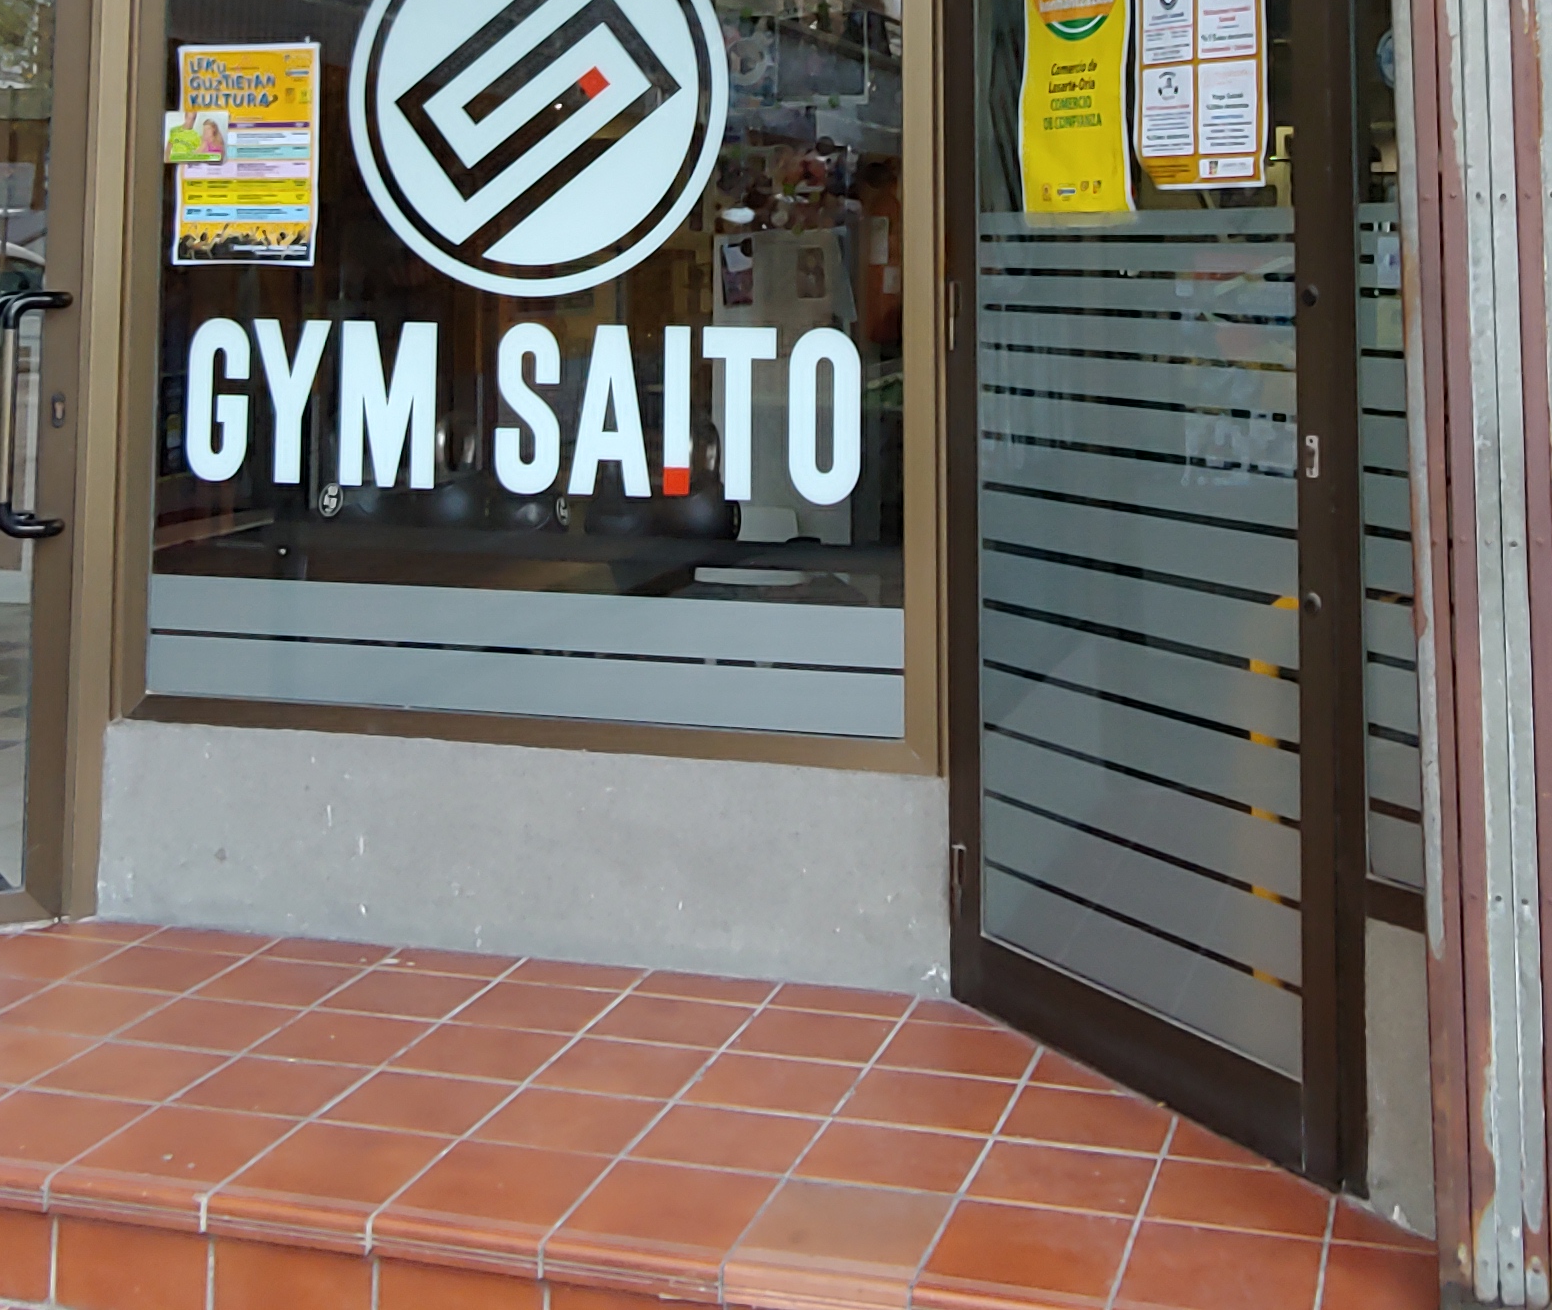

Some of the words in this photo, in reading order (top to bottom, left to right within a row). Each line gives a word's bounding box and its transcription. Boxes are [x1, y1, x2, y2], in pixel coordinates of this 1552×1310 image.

[189, 91, 270, 108] KULTURA
[186, 317, 438, 490] GYM
[494, 321, 862, 506] SAITO
